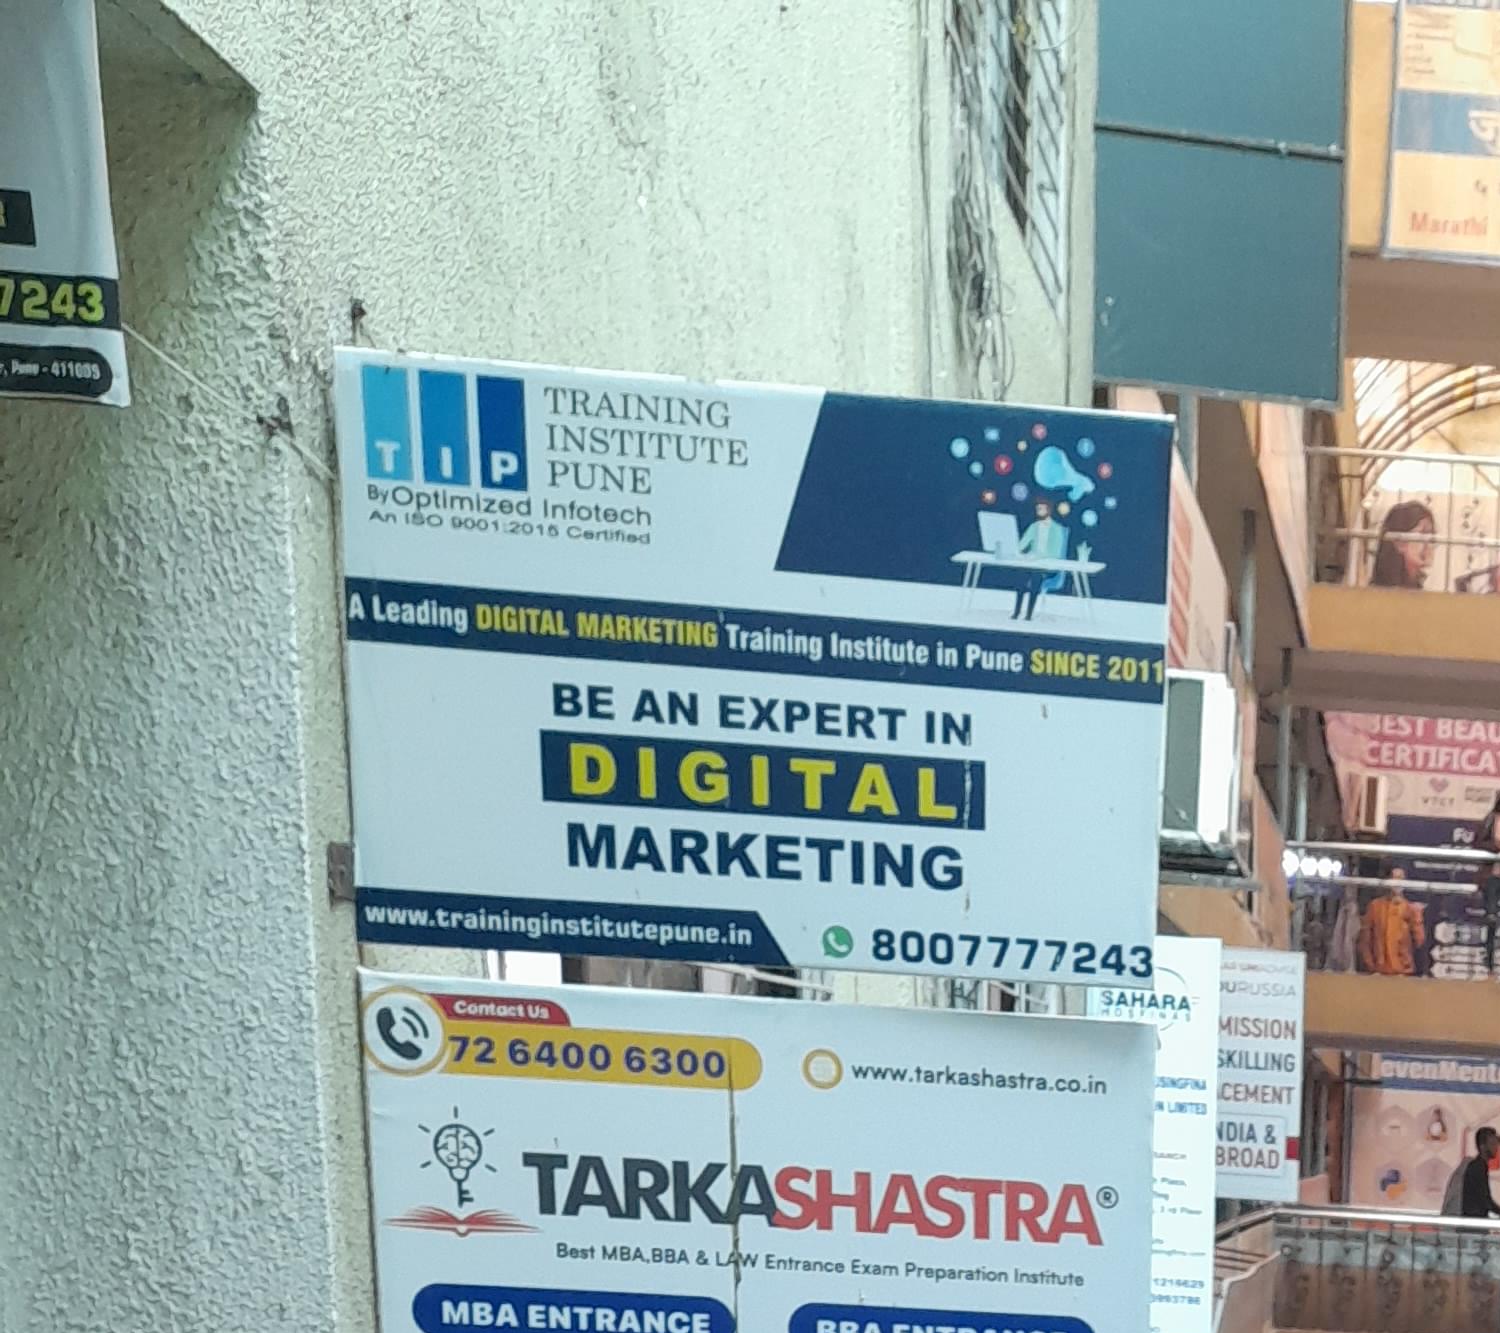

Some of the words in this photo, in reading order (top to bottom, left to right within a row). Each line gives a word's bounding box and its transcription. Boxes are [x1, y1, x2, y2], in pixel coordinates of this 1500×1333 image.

[543, 387, 732, 429] TRAINING
[546, 424, 749, 467] INSTITUTE
[547, 461, 653, 495] PUNE
[366, 485, 388, 506] By
[389, 486, 531, 517] Optimized
[543, 499, 652, 527] Infotech
[368, 510, 397, 525] An
[405, 512, 443, 528] ISO
[566, 527, 651, 545] Certified
[348, 593, 366, 620] A
[373, 594, 468, 635] Leading
[476, 604, 569, 637] DIGITAL
[577, 612, 719, 648] MARKETING
[725, 623, 822, 662] Training
[830, 632, 929, 667] Institute
[936, 642, 958, 667] in
[965, 644, 1024, 674] Pune
[1030, 649, 1100, 679] SINCE
[1108, 656, 1164, 684] 2011
[553, 683, 615, 721] BE
[632, 689, 699, 726] AN
[719, 695, 906, 741] EXPERT
[925, 711, 972, 746] IN
[569, 742, 957, 821] DIGITAL
[567, 823, 963, 892] MARKETING
[365, 904, 752, 946] www.traininginstitutepune.in
[872, 928, 1153, 978] 8007777243
[453, 999, 525, 1019] Contact
[526, 1002, 551, 1020] Us
[1100, 988, 1192, 1011] SAHARA
[448, 1036, 498, 1065] 72
[508, 1039, 612, 1072] 6400
[624, 1046, 727, 1079] 6300
[851, 1063, 1108, 1096] www.tarkashastra.co.in
[1217, 1081, 1296, 1105] CEMENT
[1263, 1123, 1277, 1145] &
[556, 1242, 596, 1261] Best
[695, 1251, 709, 1267] &
[765, 1253, 846, 1276] Entrance
[850, 1258, 900, 1278] Exam
[904, 1262, 1009, 1285] Preparation
[1013, 1268, 1085, 1288] Institute
[440, 1299, 518, 1328] MBA
